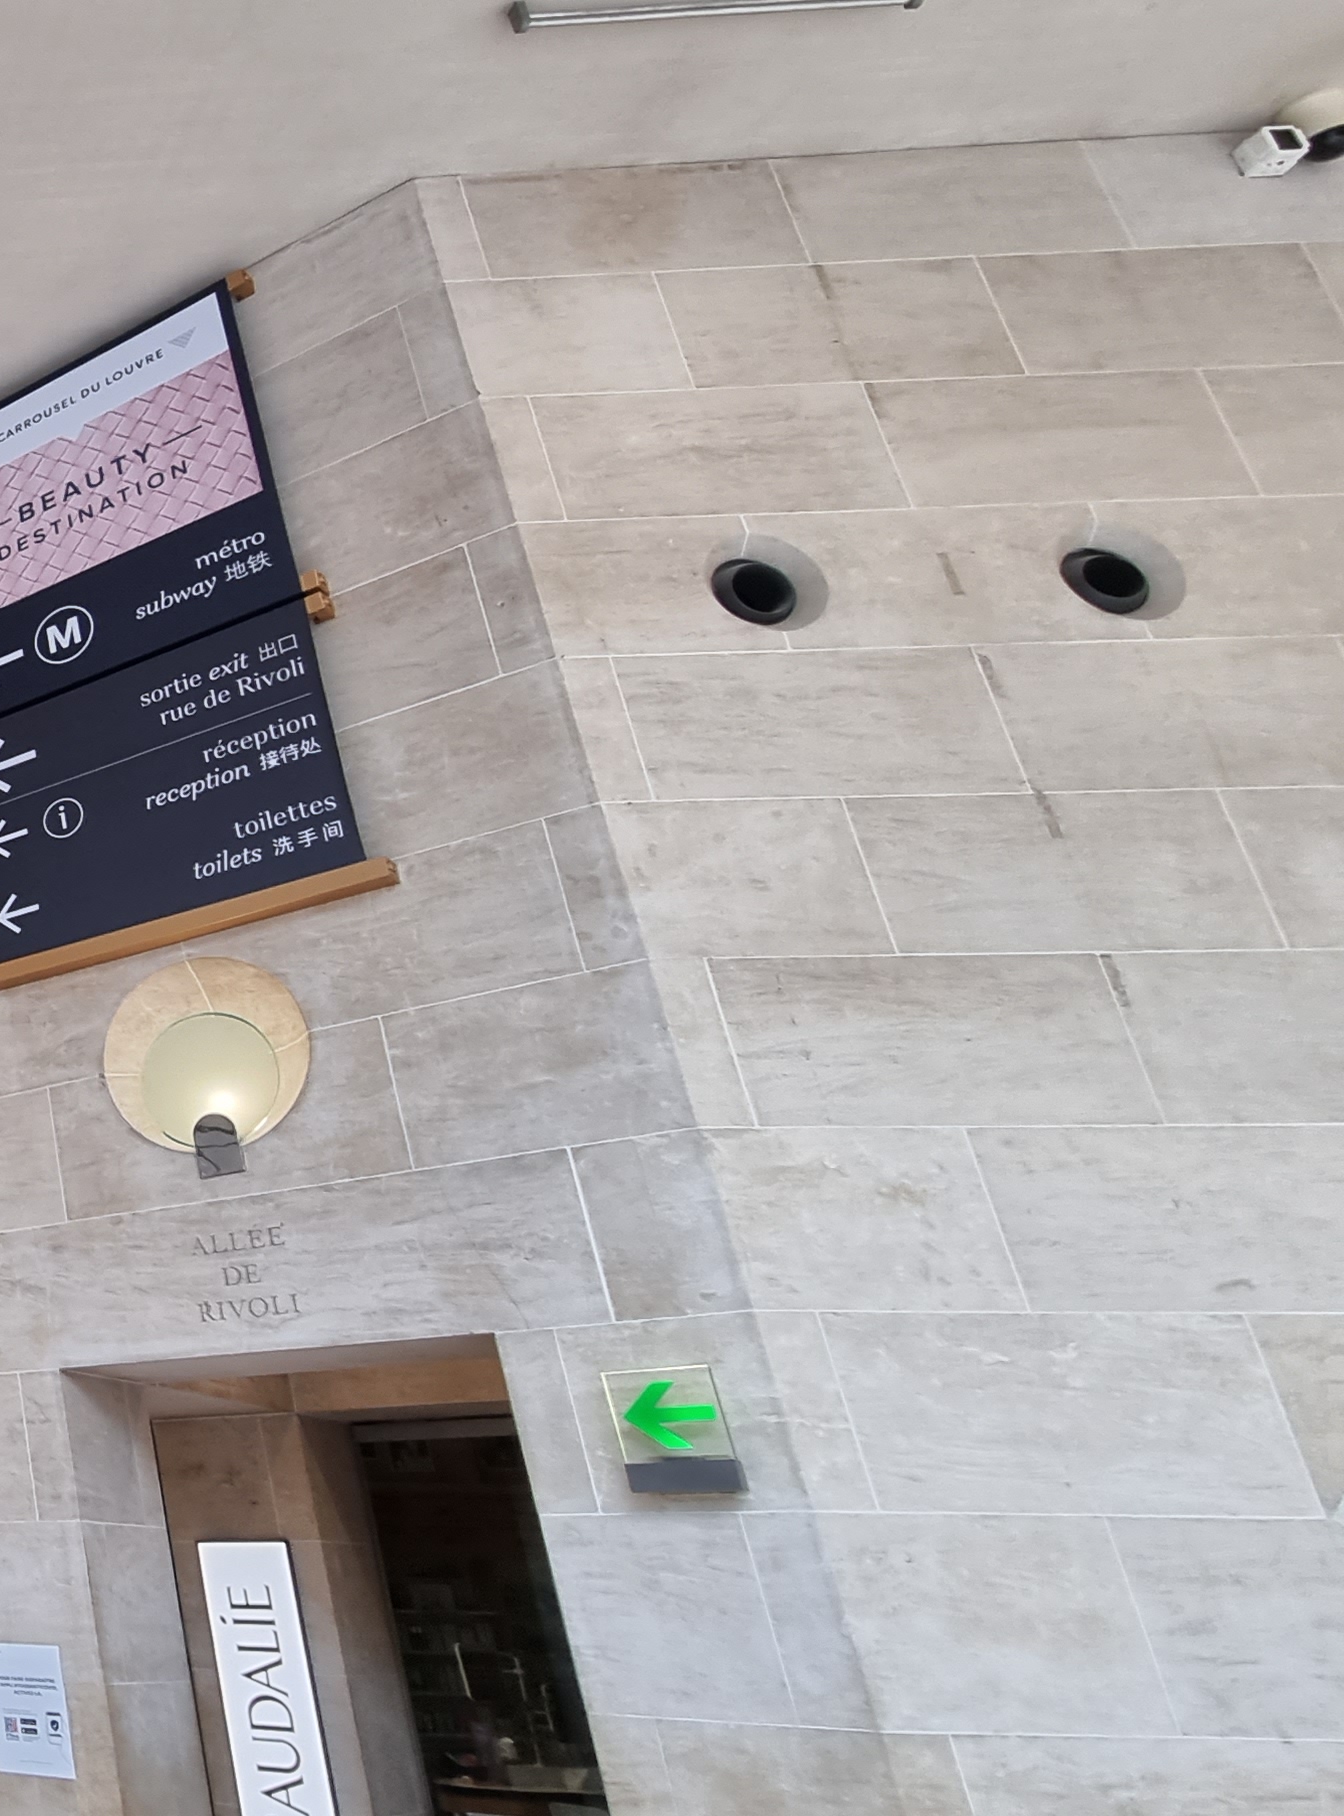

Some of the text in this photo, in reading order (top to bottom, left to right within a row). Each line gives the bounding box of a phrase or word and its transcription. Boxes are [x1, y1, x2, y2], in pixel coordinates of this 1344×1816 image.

[80, 382, 101, 400] DU
[105, 349, 164, 387] LOUVRE
[18, 442, 152, 524] BEAUTY
[195, 531, 266, 570] métro
[136, 551, 273, 620] subway 地铁
[139, 634, 299, 708] sortie exit 出口
[159, 656, 306, 726] rue de Rivoli
[202, 711, 318, 764] réception
[144, 737, 323, 810] reception 接待处
[233, 794, 338, 840] toilettes
[192, 820, 345, 880] toilets 洗手间
[221, 1263, 262, 1286] DE
[198, 1293, 303, 1323] RIVOLI
[219, 1584, 311, 1816] AUDALÍE
